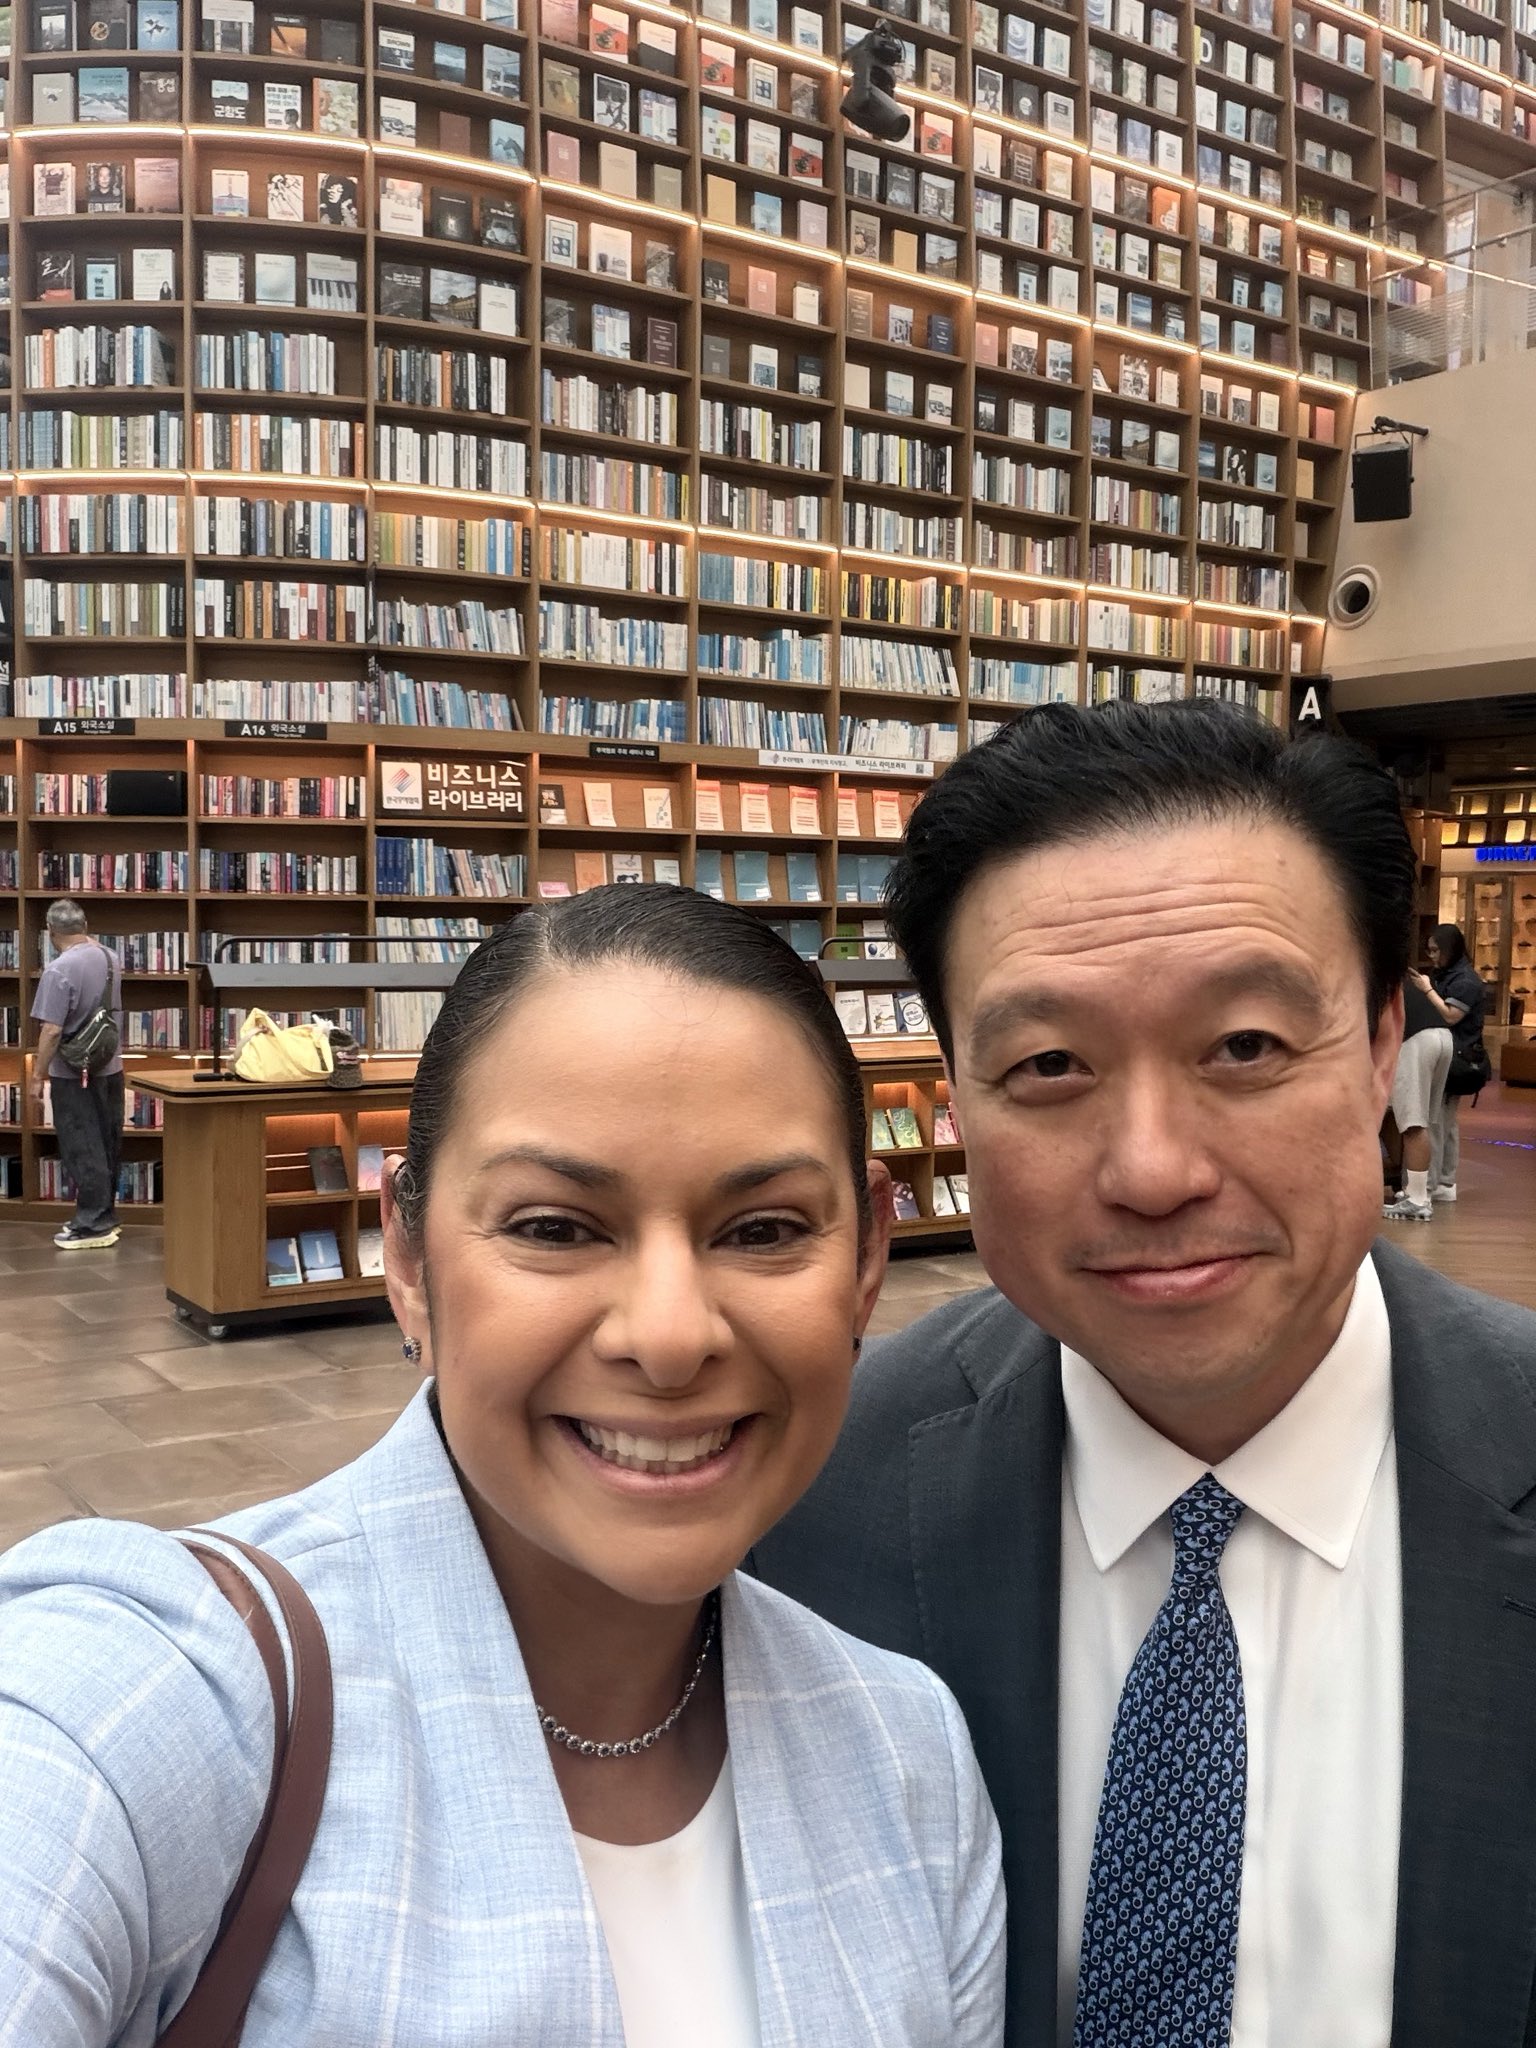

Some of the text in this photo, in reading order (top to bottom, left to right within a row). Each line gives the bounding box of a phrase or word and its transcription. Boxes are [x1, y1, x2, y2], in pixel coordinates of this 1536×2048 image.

[1298, 686, 1322, 721] A
[53, 721, 115, 733] A15 외국소설
[241, 724, 306, 735] A16 외국소설
[427, 763, 522, 789] 비즈니스
[428, 790, 523, 812] 라이브러리
